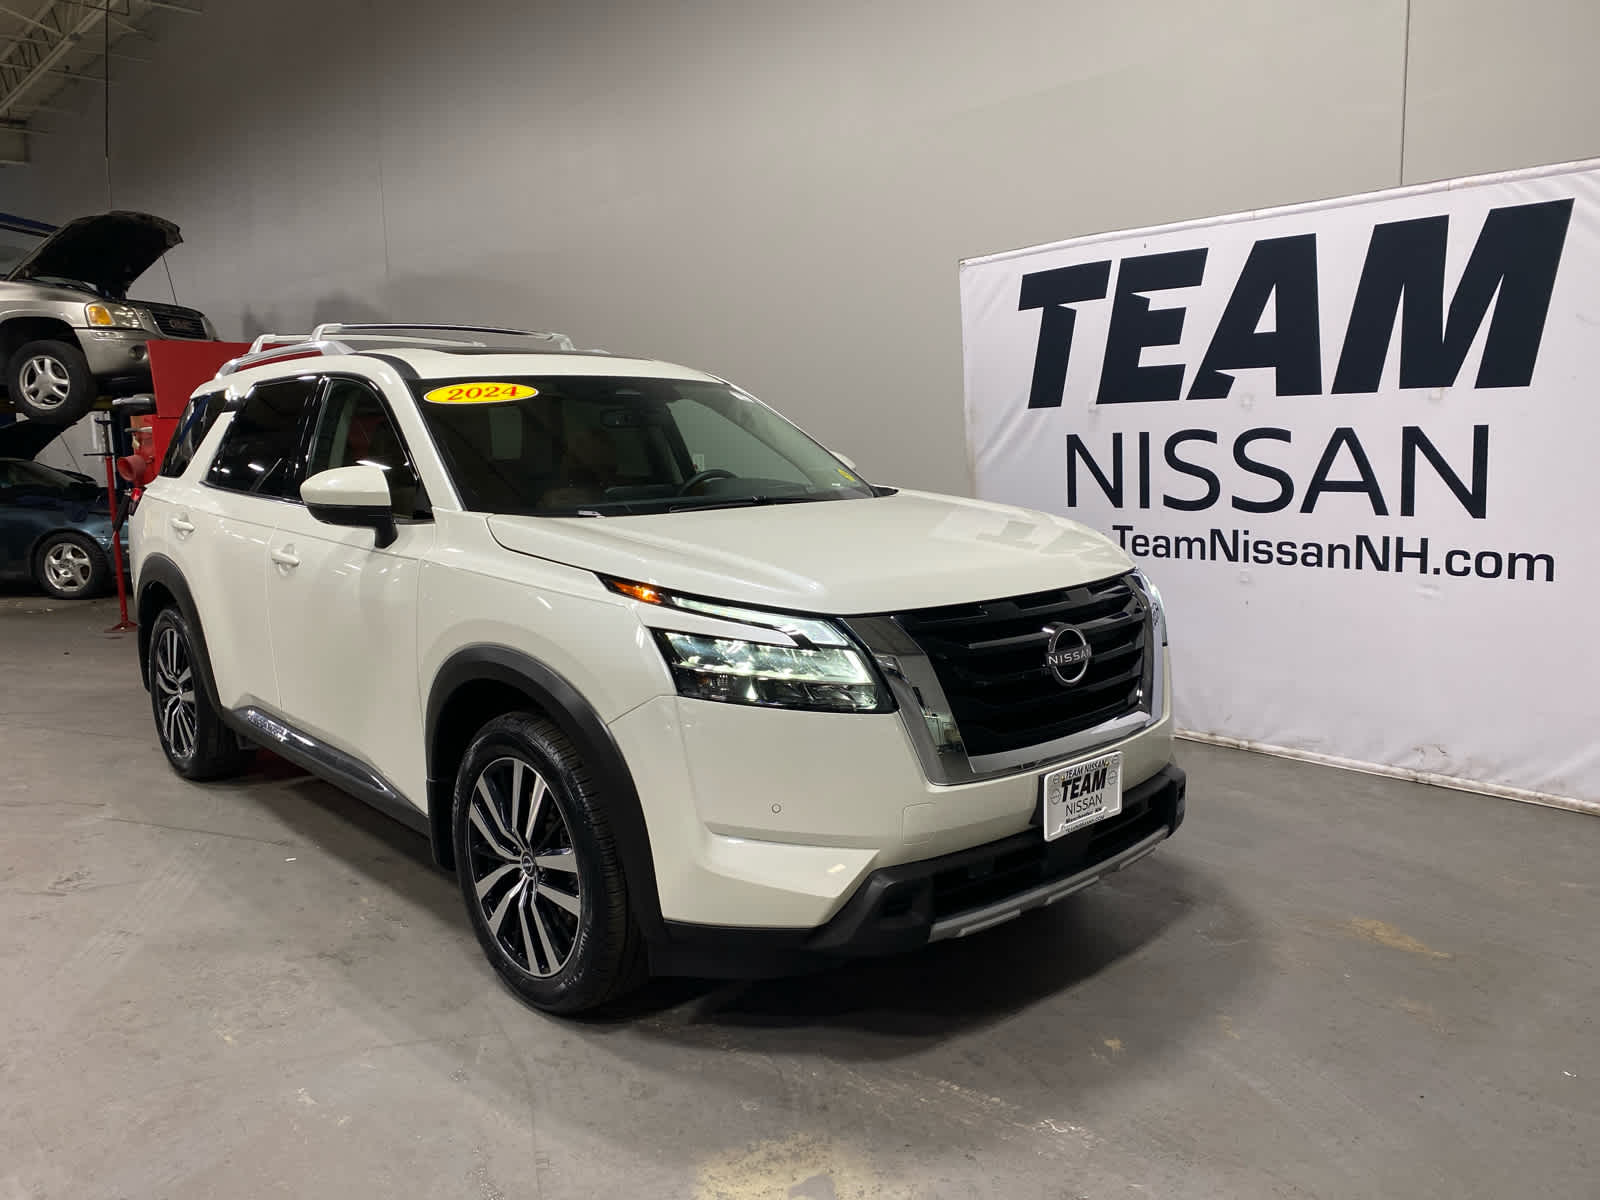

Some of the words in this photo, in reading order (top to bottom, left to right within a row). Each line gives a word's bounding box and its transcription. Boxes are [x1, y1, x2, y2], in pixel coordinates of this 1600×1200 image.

[1018, 198, 1575, 410] TEAM
[447, 386, 518, 401] 2024
[1066, 424, 1489, 520] NISSAN
[1111, 524, 1555, 582] TeamNissanNH.com
[1061, 767, 1107, 802] TEAM
[1065, 765, 1083, 779] TEAM
[1065, 793, 1103, 817] NISSAN
